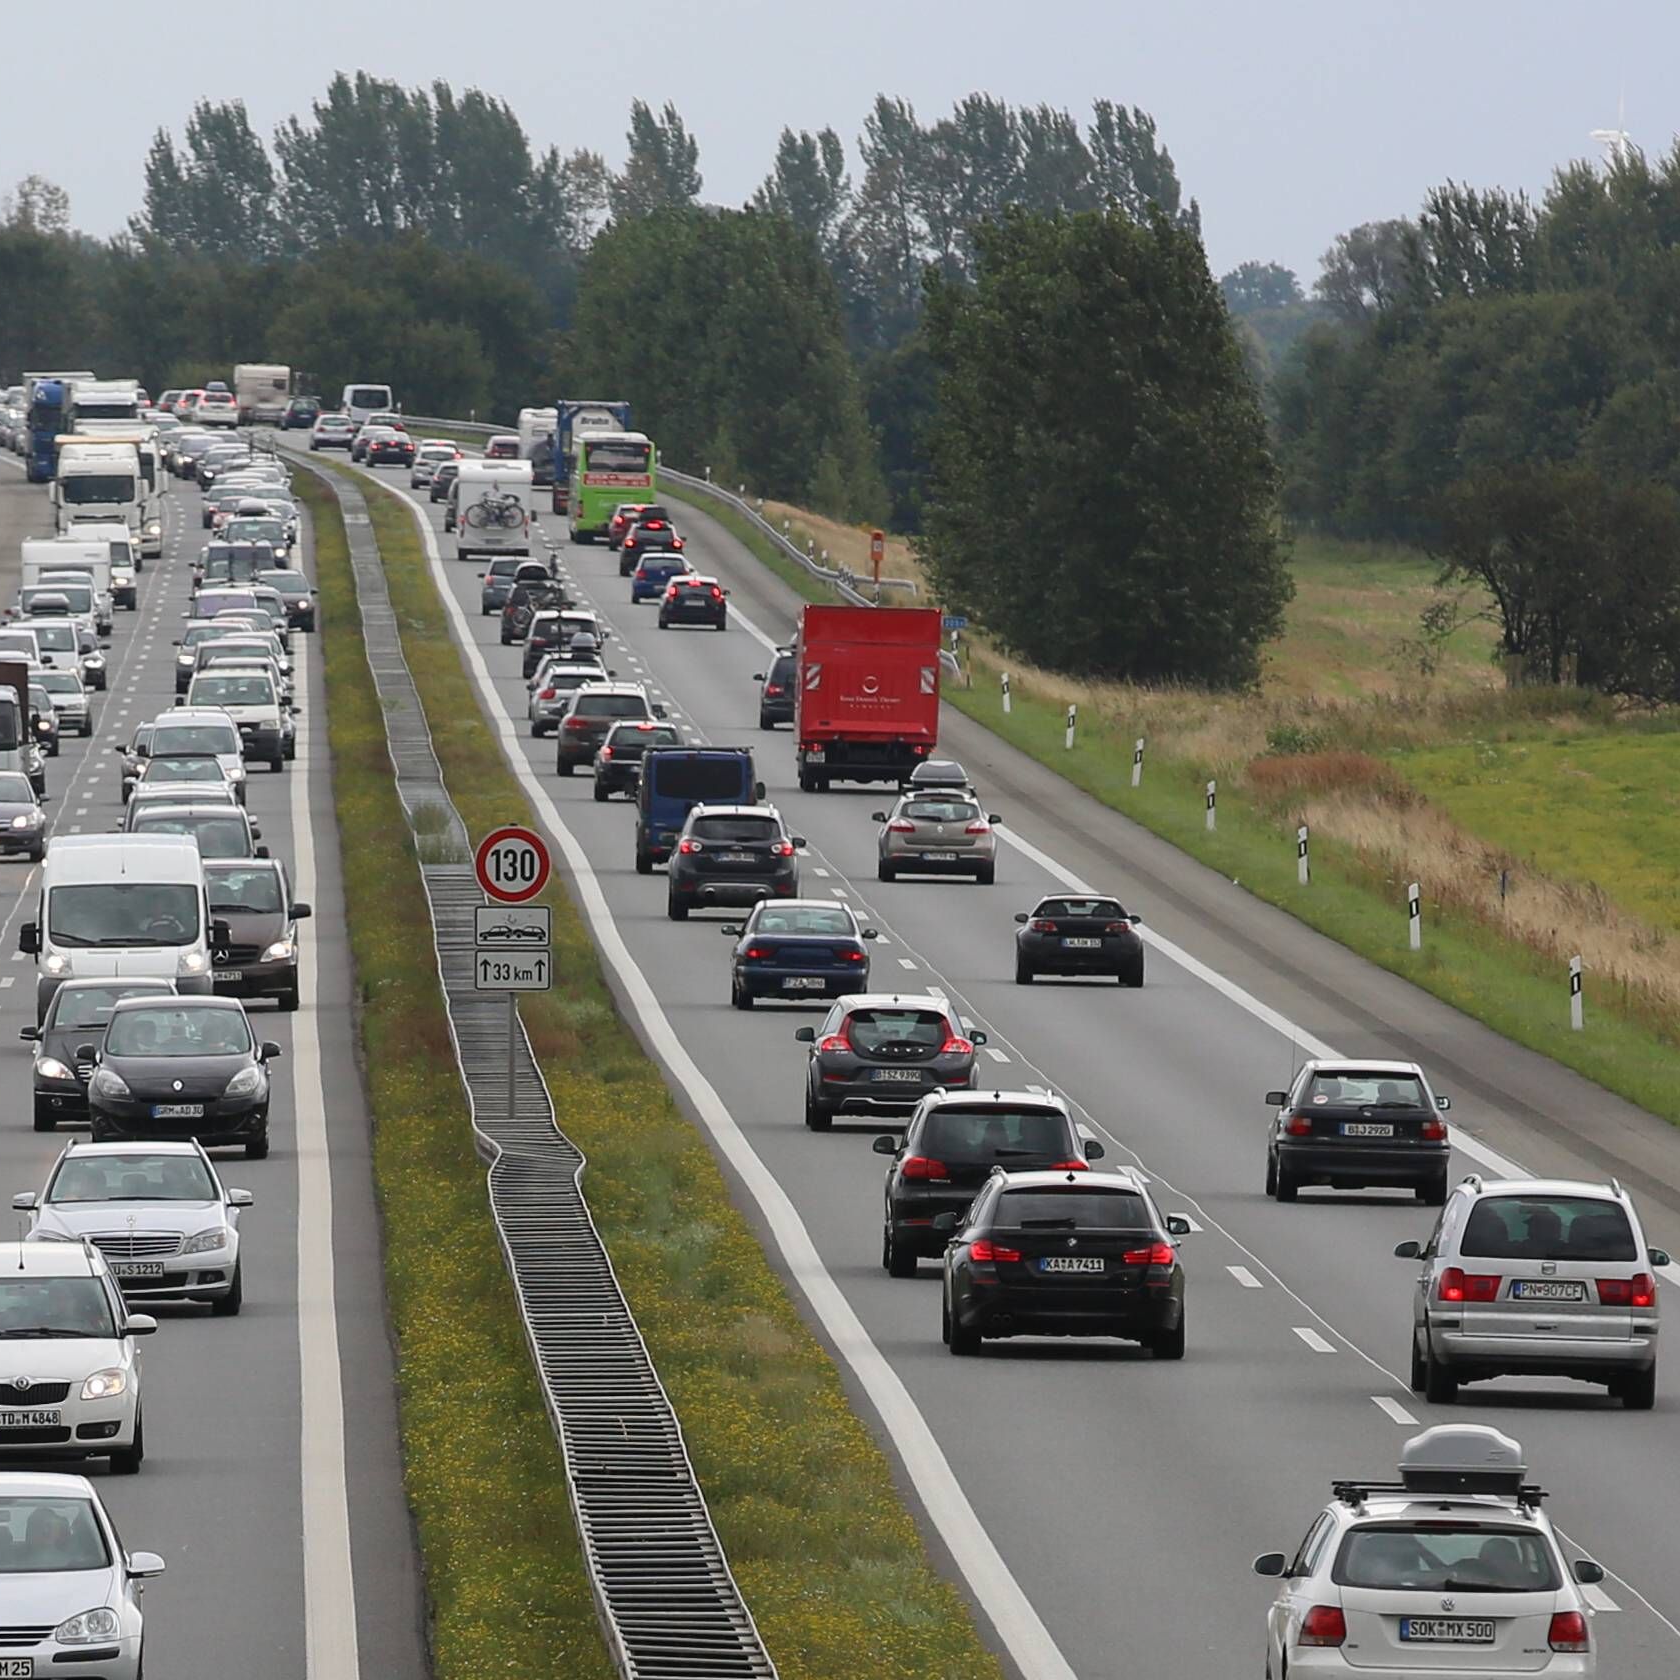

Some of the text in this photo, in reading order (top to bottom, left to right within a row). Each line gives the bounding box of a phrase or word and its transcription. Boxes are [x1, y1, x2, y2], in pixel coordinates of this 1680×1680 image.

[491, 849, 536, 882] 130
[493, 963, 533, 981] 33 km
[127, 1265, 133, 1275] S
[134, 1264, 161, 1274] 1212
[1076, 1259, 1102, 1270] 7411
[1522, 1284, 1579, 1297] PN 907CF
[32, 1412, 59, 1424] 4848
[1410, 1621, 1492, 1638] SOK MX 500
[12, 1661, 30, 1676] 25
